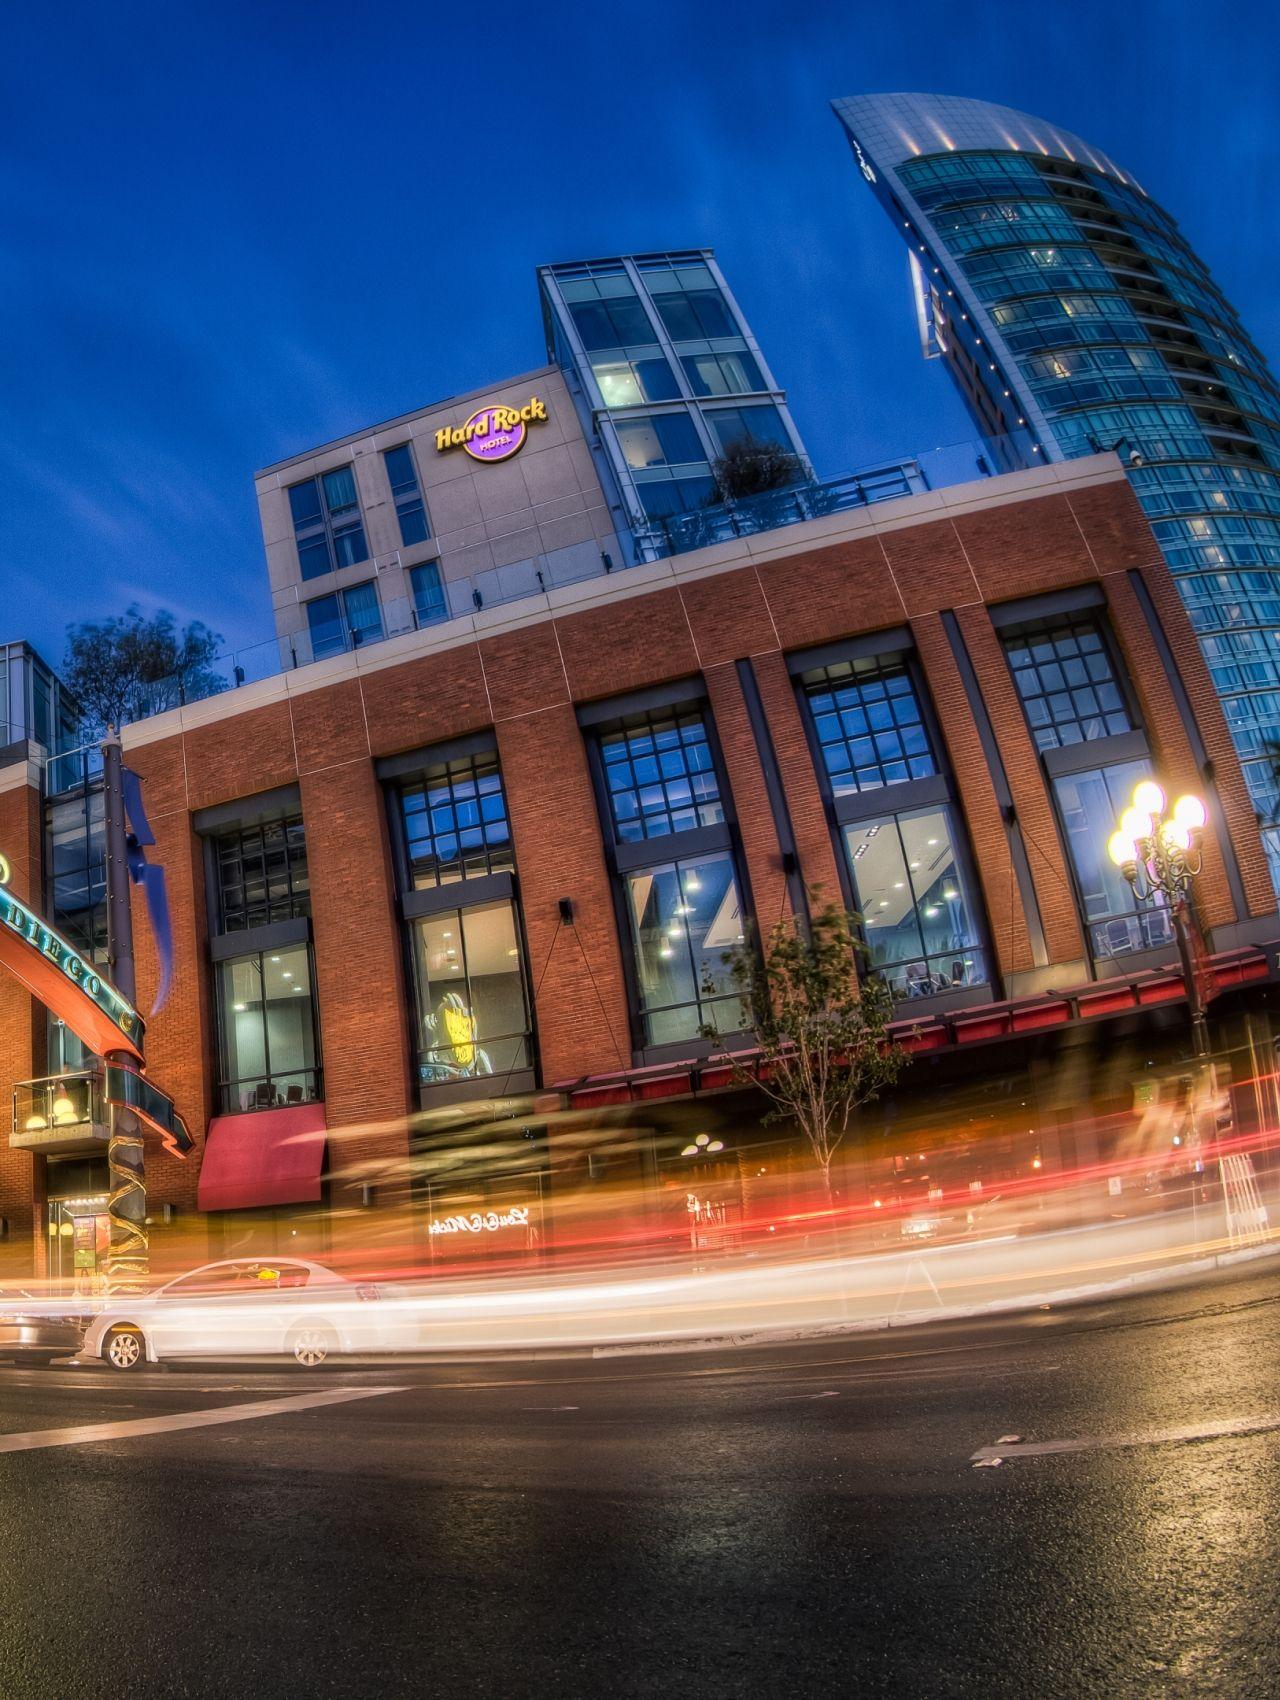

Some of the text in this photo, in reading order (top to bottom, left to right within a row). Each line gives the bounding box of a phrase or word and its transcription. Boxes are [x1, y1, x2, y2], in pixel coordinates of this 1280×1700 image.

[435, 396, 548, 451] Hard Rock
[480, 435, 512, 452] HOTEL
[6, 904, 102, 997] DIEGO
